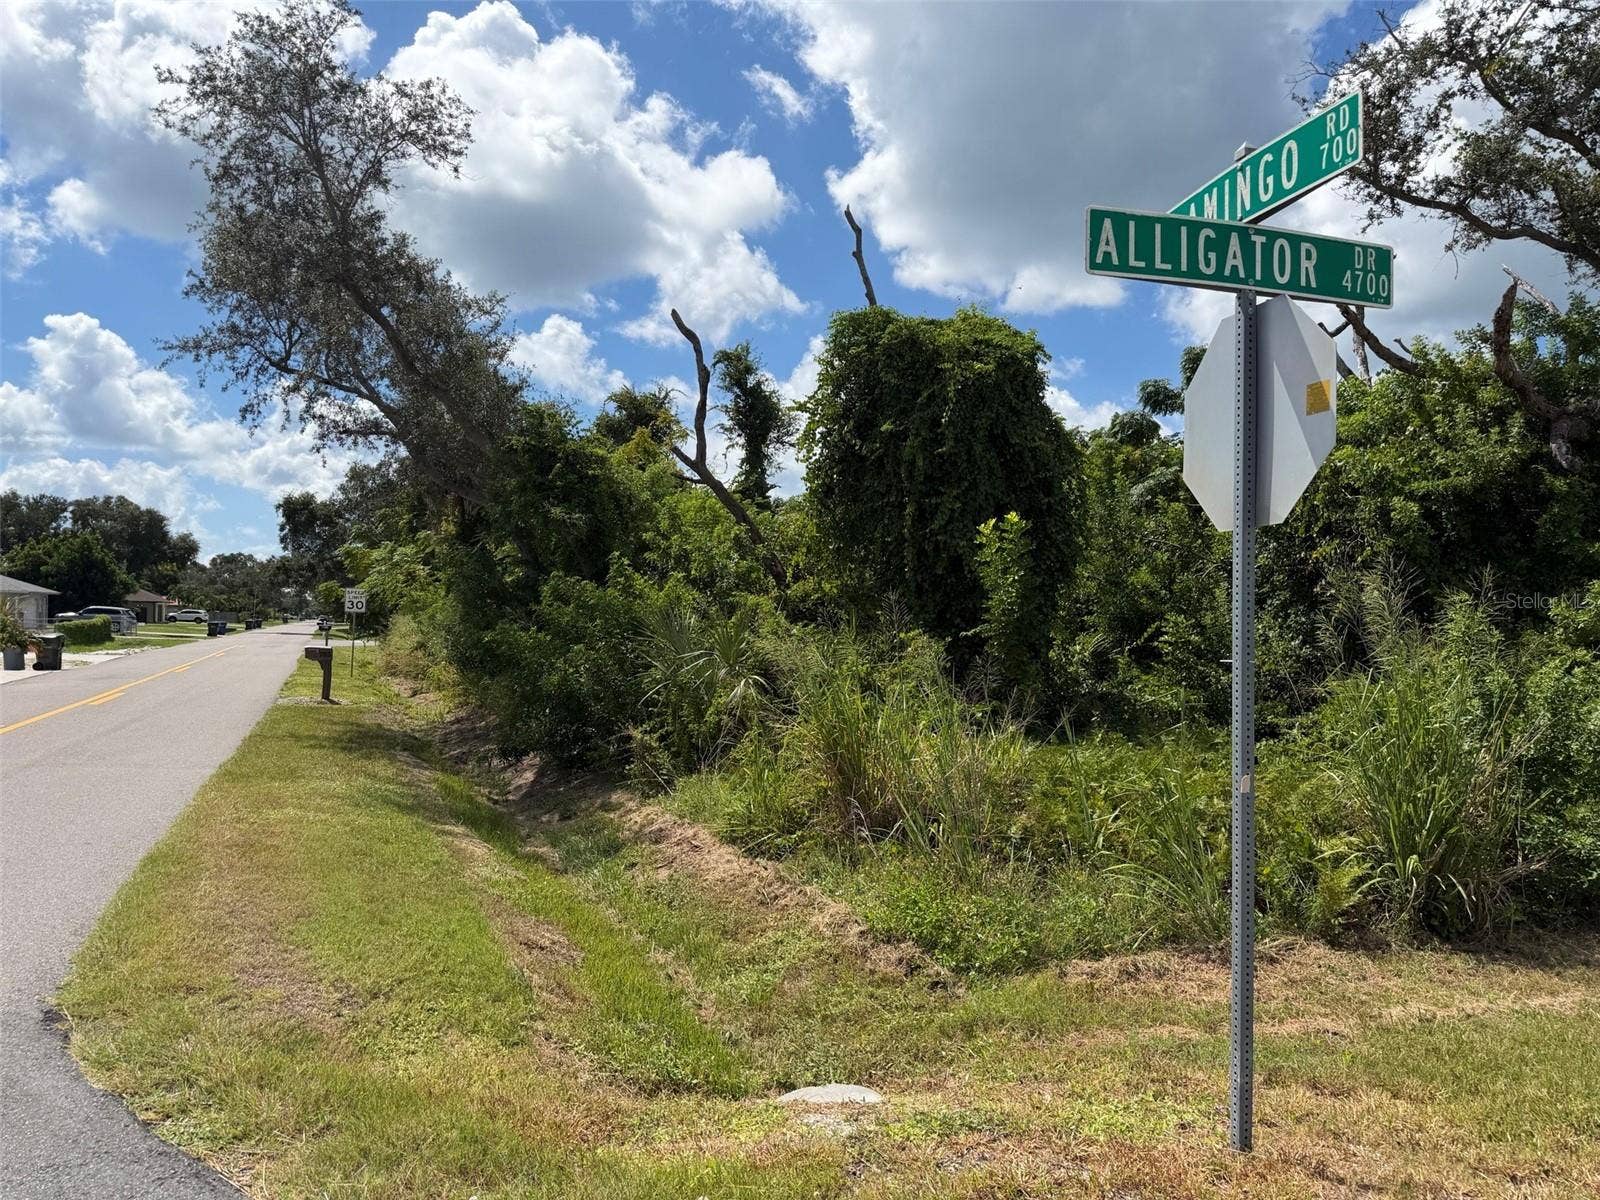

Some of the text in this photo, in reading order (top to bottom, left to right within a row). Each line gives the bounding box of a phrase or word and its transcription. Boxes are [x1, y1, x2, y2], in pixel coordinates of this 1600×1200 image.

[1326, 104, 1349, 139] RD
[1319, 128, 1357, 170] 700
[1095, 217, 1376, 288] ALLIGATOR DR
[1342, 269, 1388, 297] 4700
[347, 600, 364, 610] 30
